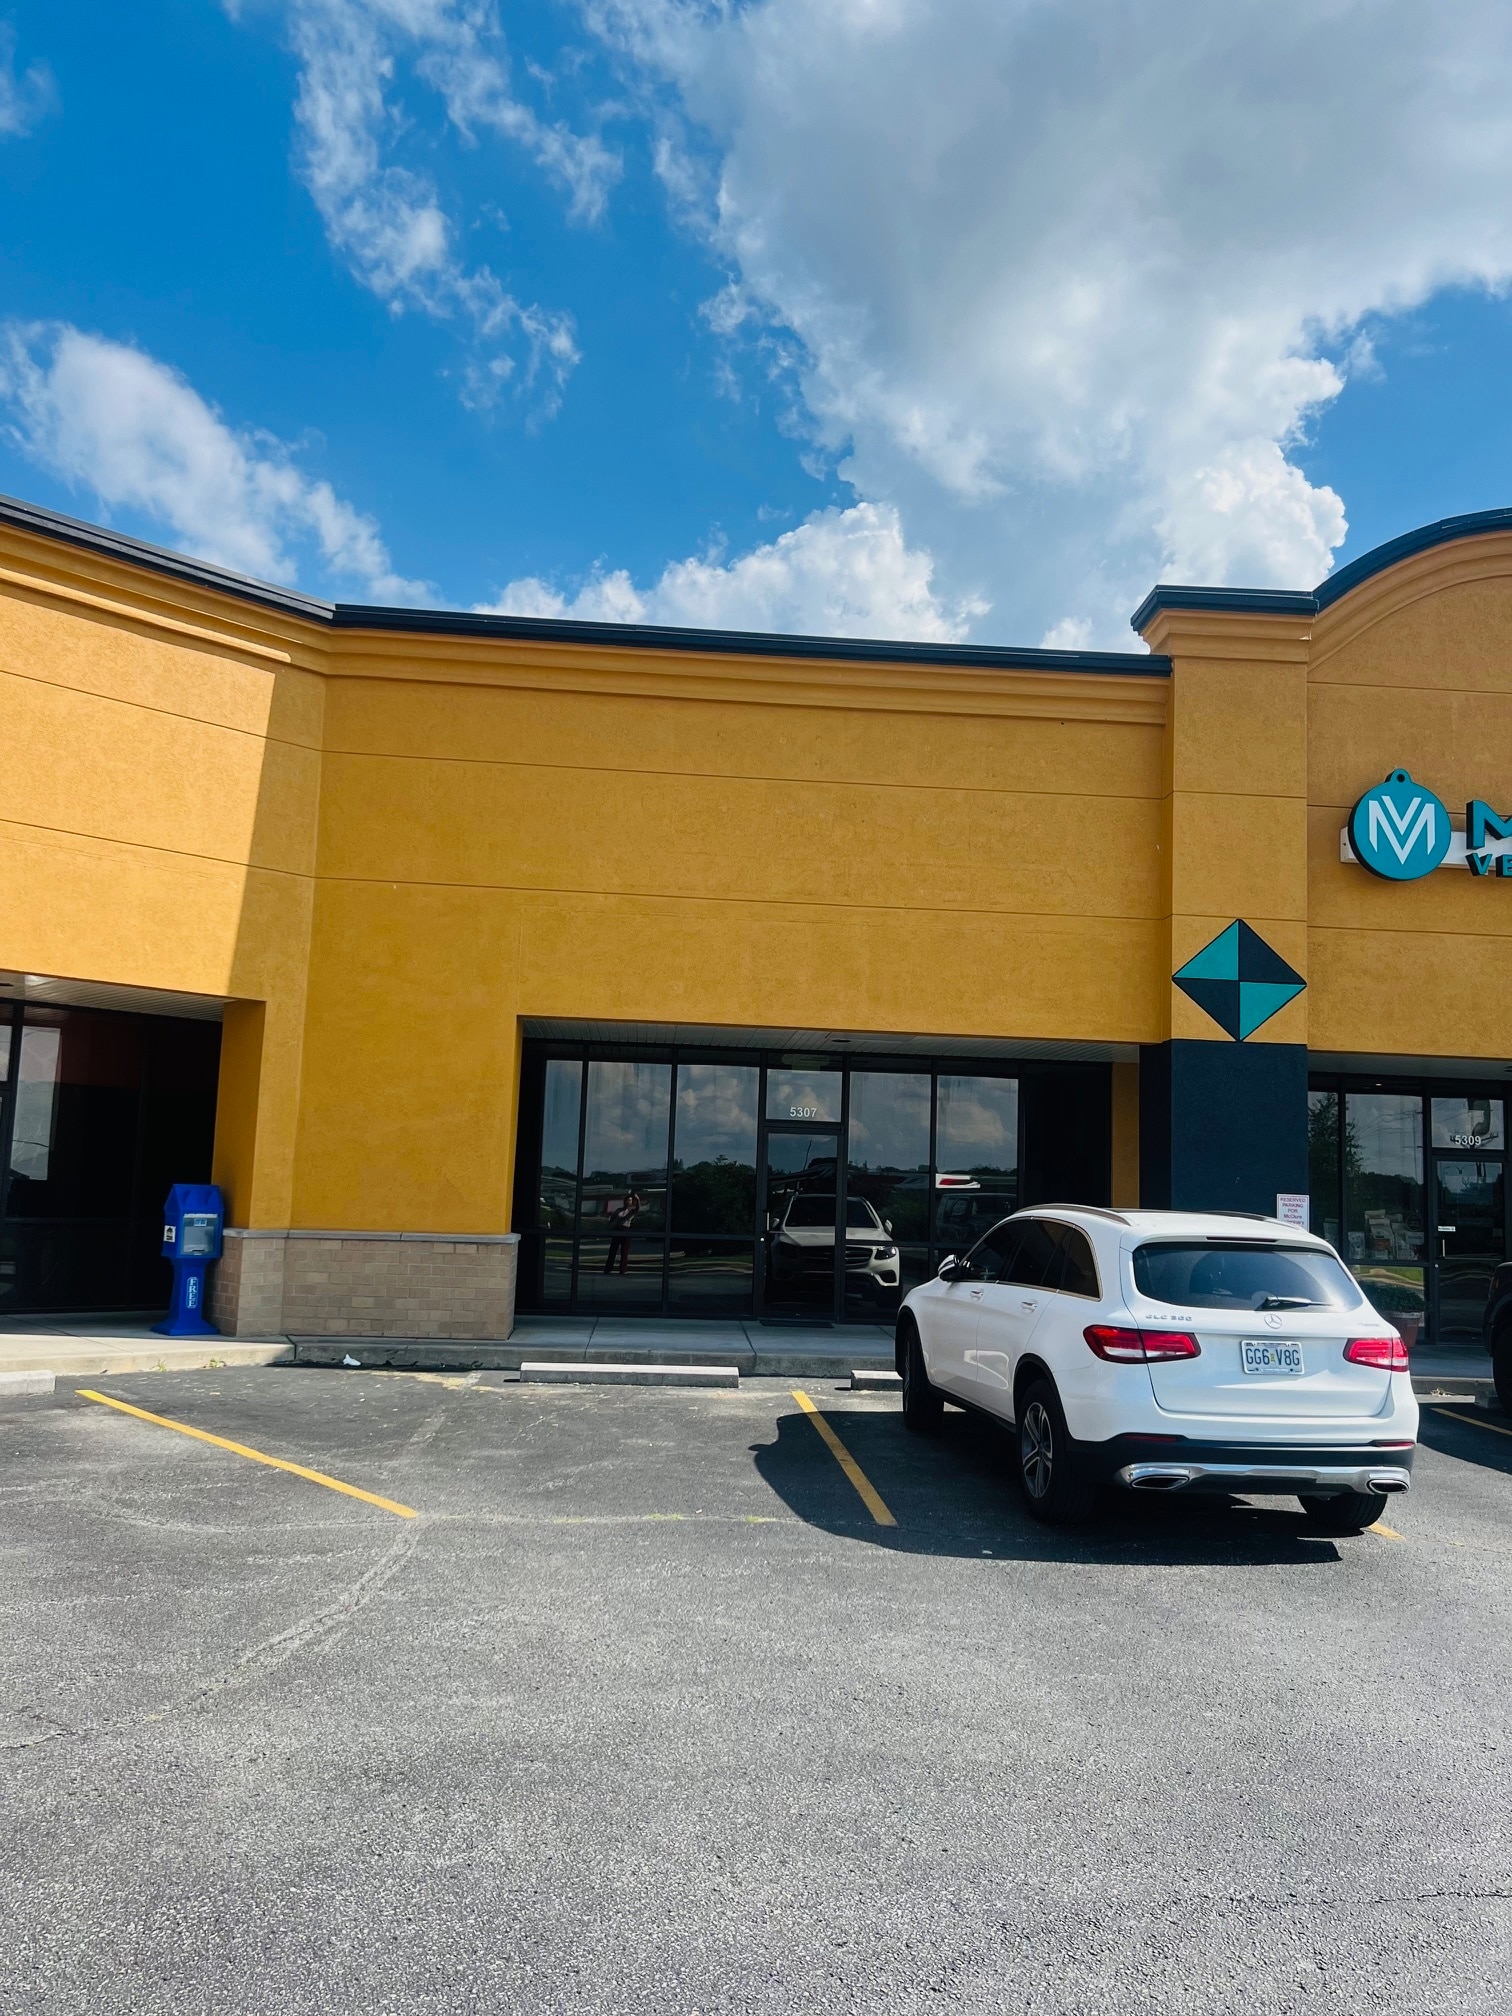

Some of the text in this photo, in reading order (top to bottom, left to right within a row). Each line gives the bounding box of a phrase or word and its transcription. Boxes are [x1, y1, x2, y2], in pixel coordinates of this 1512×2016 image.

[789, 1106, 818, 1118] 5307
[1454, 1134, 1482, 1146] 5309
[188, 1278, 197, 1307] FREE
[1245, 1348, 1300, 1366] GG6 V8G
